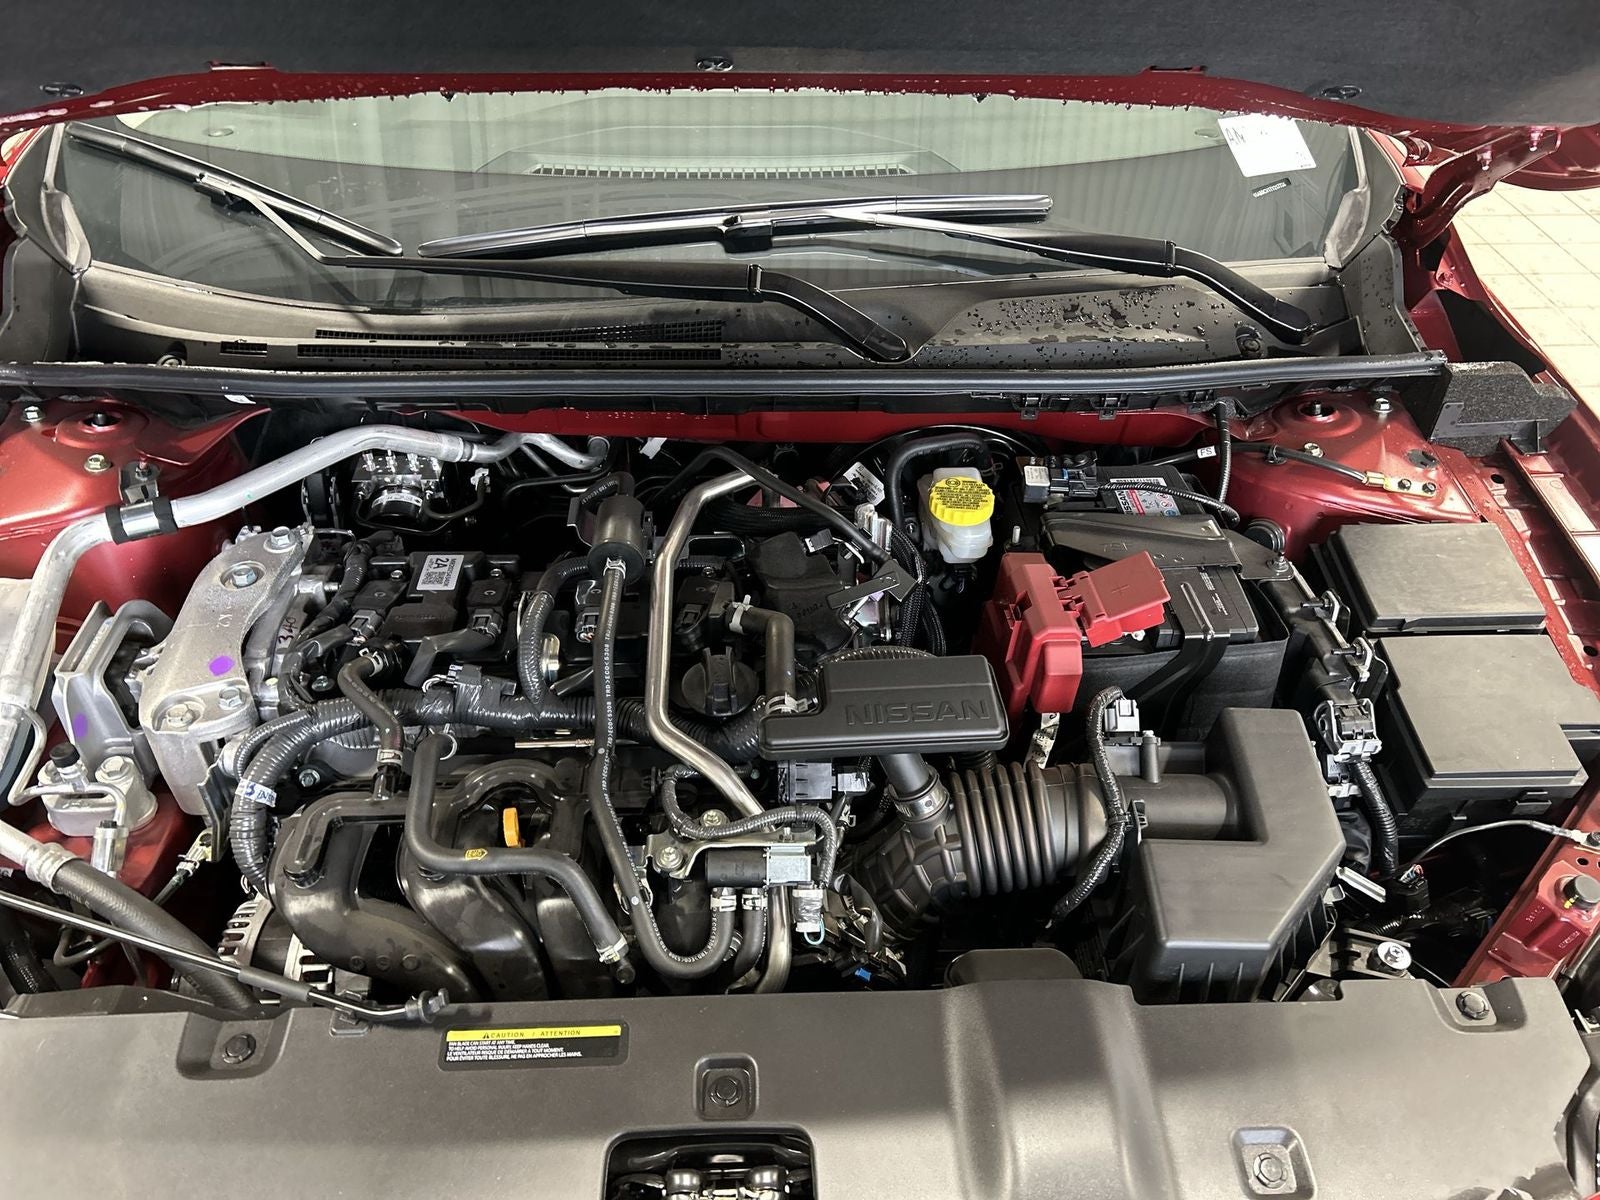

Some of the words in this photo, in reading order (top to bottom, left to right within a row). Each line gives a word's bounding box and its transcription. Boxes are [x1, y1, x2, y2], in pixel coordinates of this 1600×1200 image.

[1200, 447, 1212, 456] FS
[432, 558, 450, 570] 2A
[846, 700, 991, 725] NISSAN
